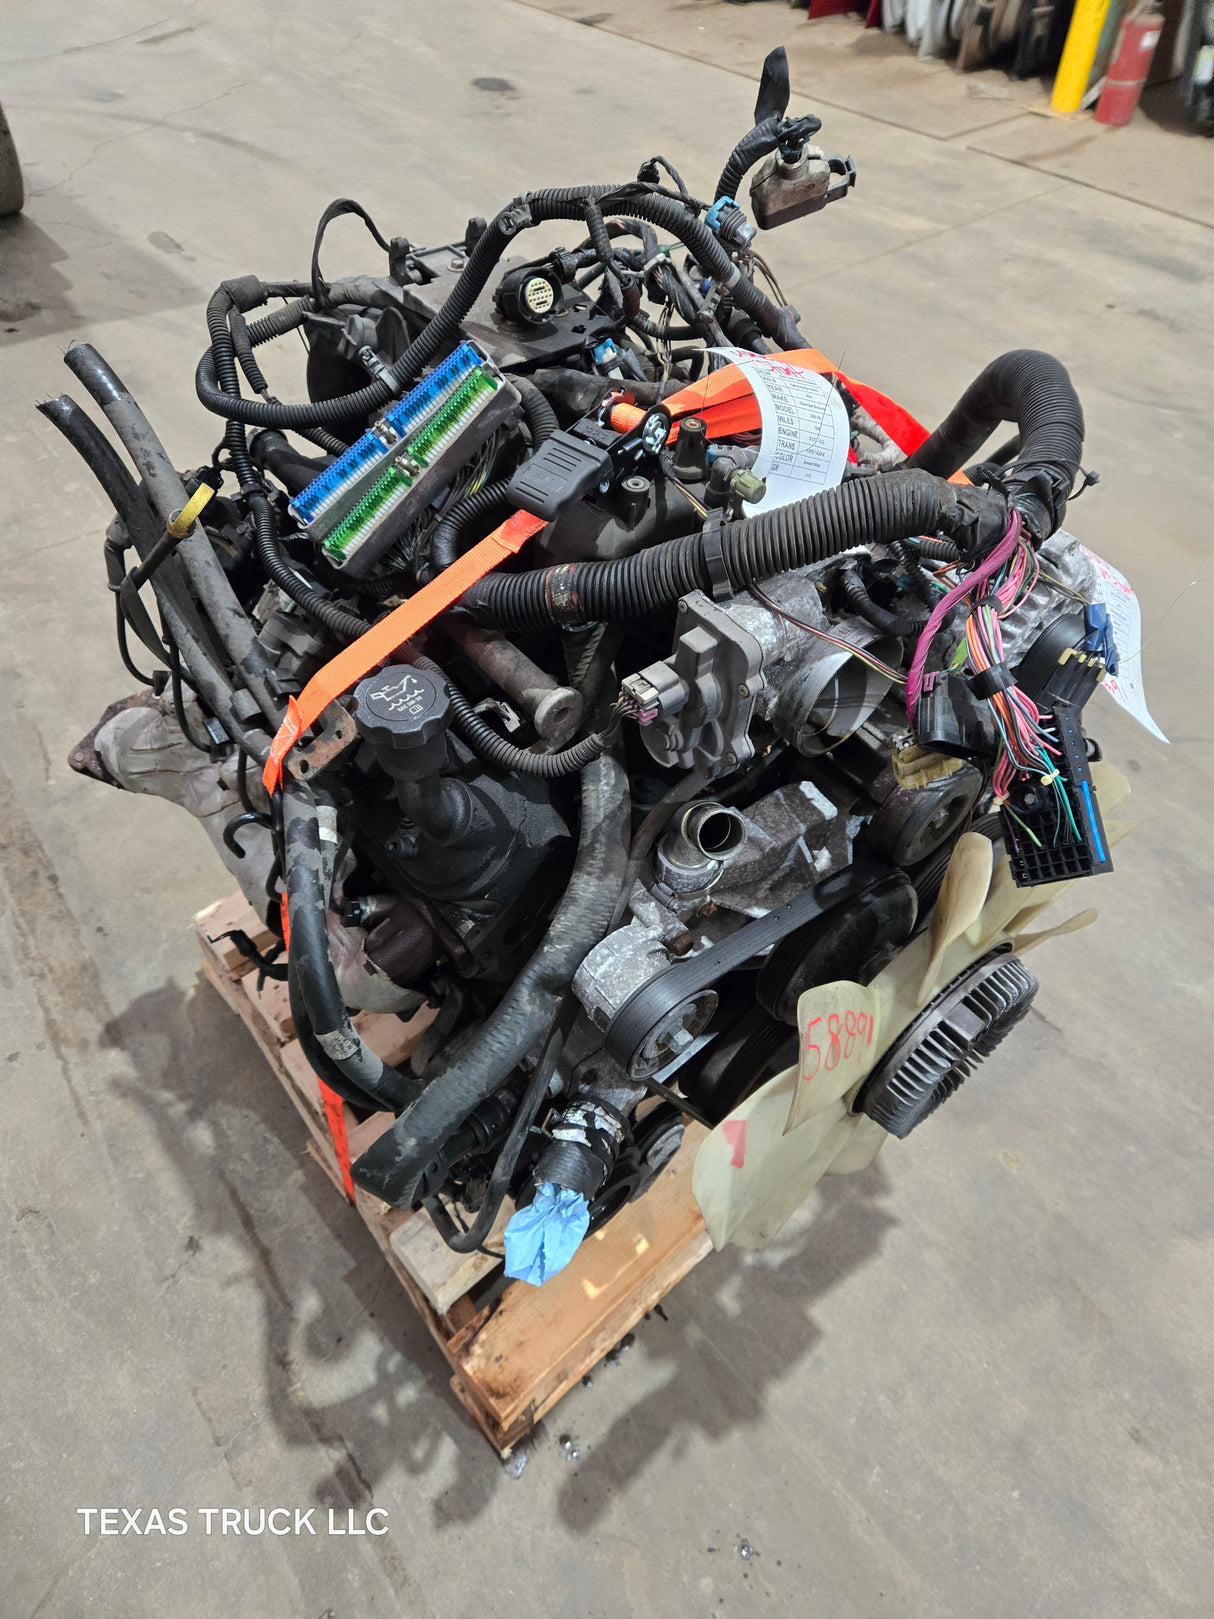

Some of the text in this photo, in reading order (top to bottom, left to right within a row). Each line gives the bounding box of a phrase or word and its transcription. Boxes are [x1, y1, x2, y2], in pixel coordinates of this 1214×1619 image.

[767, 384, 784, 393] YEAR
[771, 392, 789, 403] MAKE
[774, 403, 796, 415] MODEL
[777, 415, 795, 426] MILES
[778, 426, 799, 439] ENGINE
[778, 439, 796, 451] TRANS
[774, 451, 794, 462] COLOR
[802, 1009, 874, 1082] 58891
